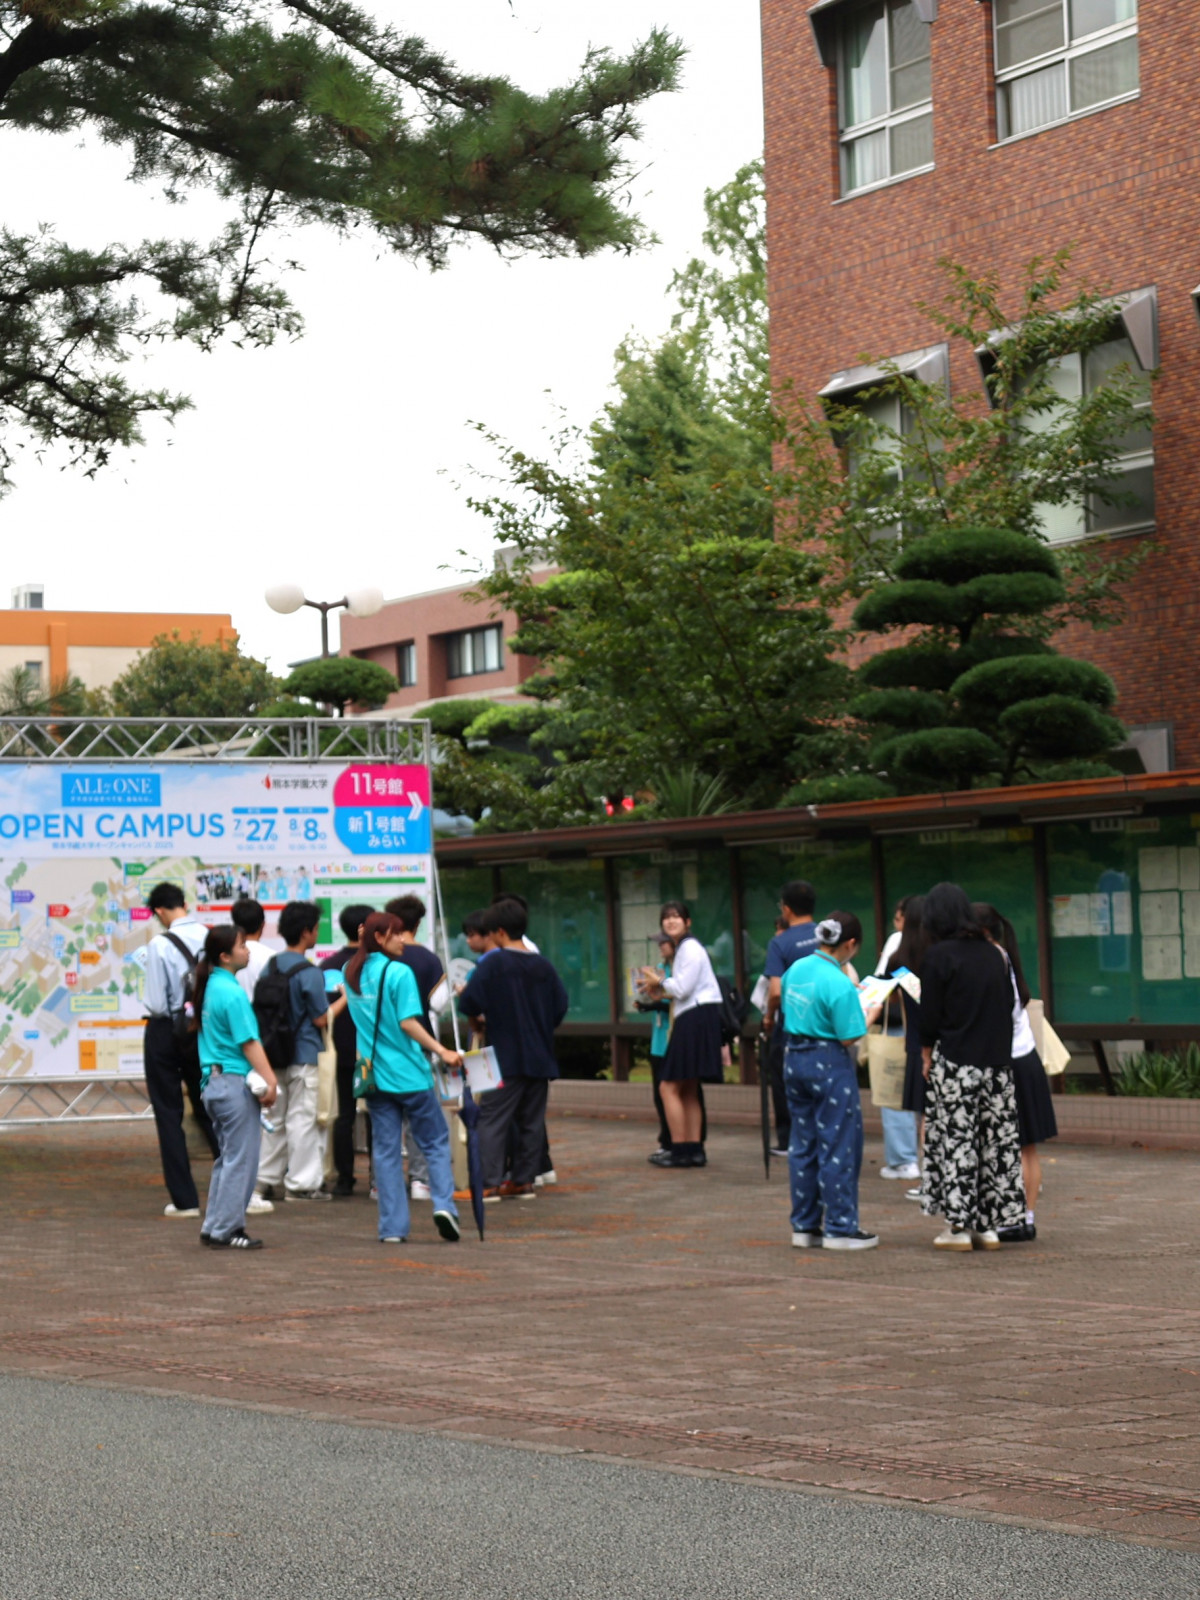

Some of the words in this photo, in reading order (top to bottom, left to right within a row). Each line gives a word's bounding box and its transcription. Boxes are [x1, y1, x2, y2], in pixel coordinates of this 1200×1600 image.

[113, 777, 153, 795] ONE
[272, 778, 329, 790] 熊本学園大学
[351, 773, 404, 796] 11号館
[94, 813, 226, 839] CAMPUS
[348, 811, 406, 833] 新1号館
[367, 835, 406, 848] みらい
